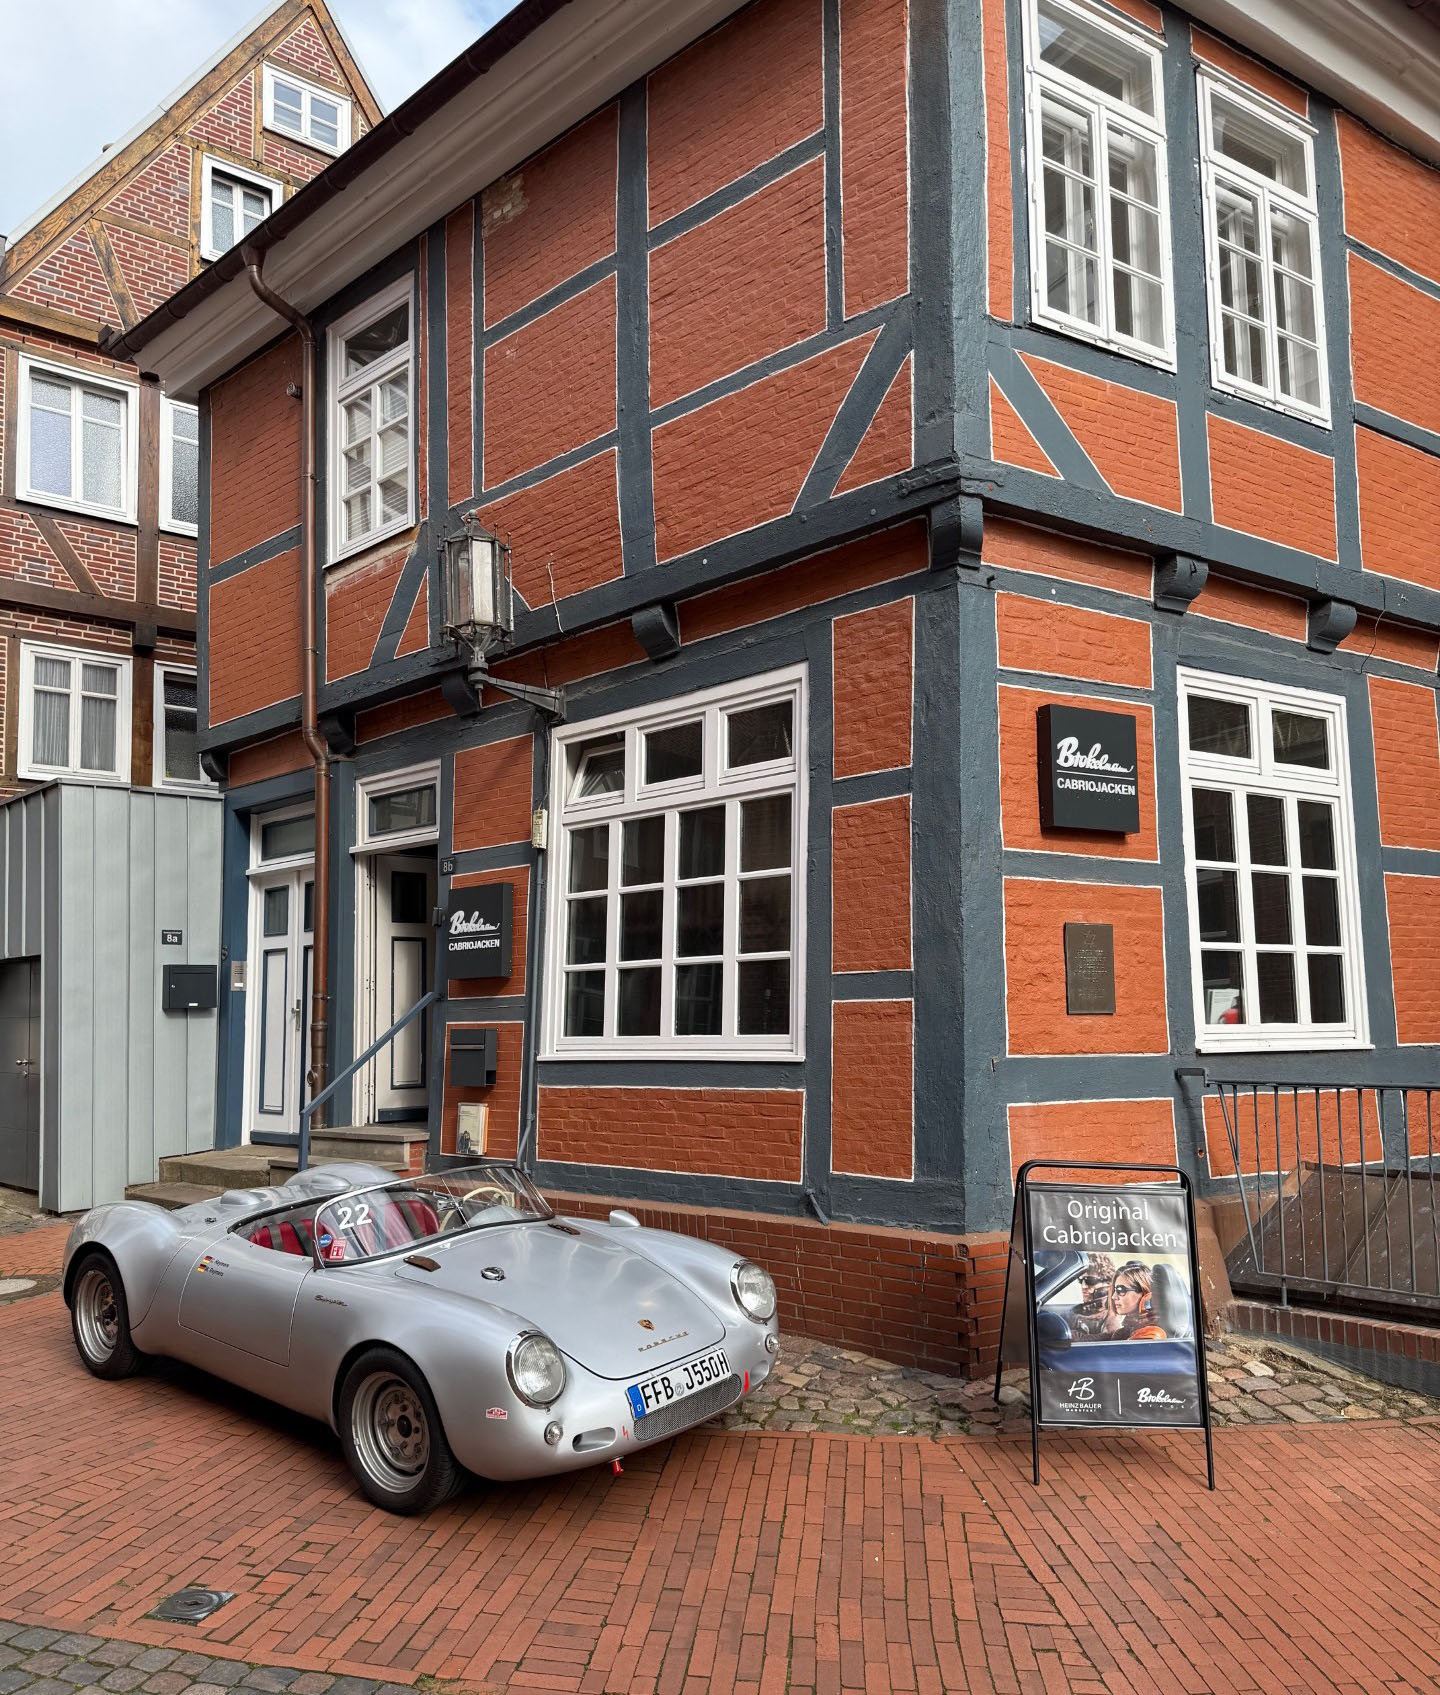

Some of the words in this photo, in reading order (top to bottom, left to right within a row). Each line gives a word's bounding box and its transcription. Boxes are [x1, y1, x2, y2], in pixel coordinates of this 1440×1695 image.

[1056, 777, 1136, 796] CABRIOJACKEN
[443, 861, 454, 873] 8b
[166, 934, 178, 943] 8a
[448, 938, 500, 952] CABRIOJACKEN
[337, 1203, 373, 1230] 22
[1067, 1200, 1149, 1224] Original
[1043, 1225, 1177, 1250] Cabriojacken
[640, 1376, 675, 1409] FFB
[682, 1351, 730, 1390] J550H
